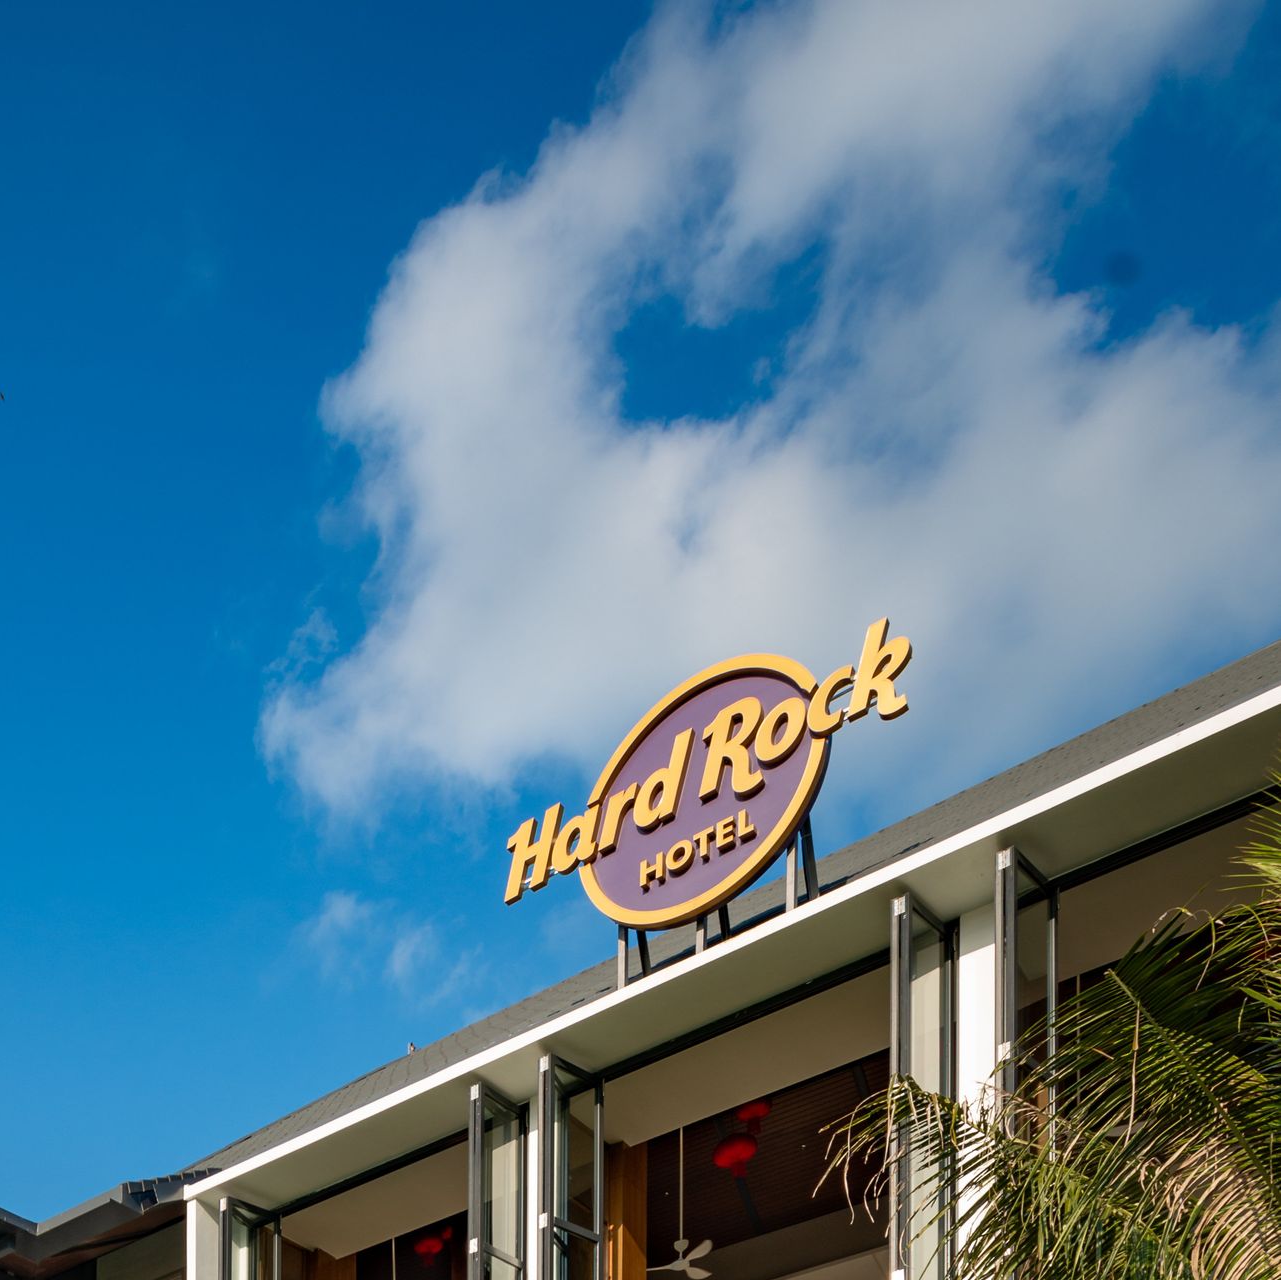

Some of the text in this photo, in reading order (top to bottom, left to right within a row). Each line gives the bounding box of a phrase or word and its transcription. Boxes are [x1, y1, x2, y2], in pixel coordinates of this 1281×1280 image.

[505, 617, 912, 904] Hard Rock
[639, 809, 757, 891] HOTEL
